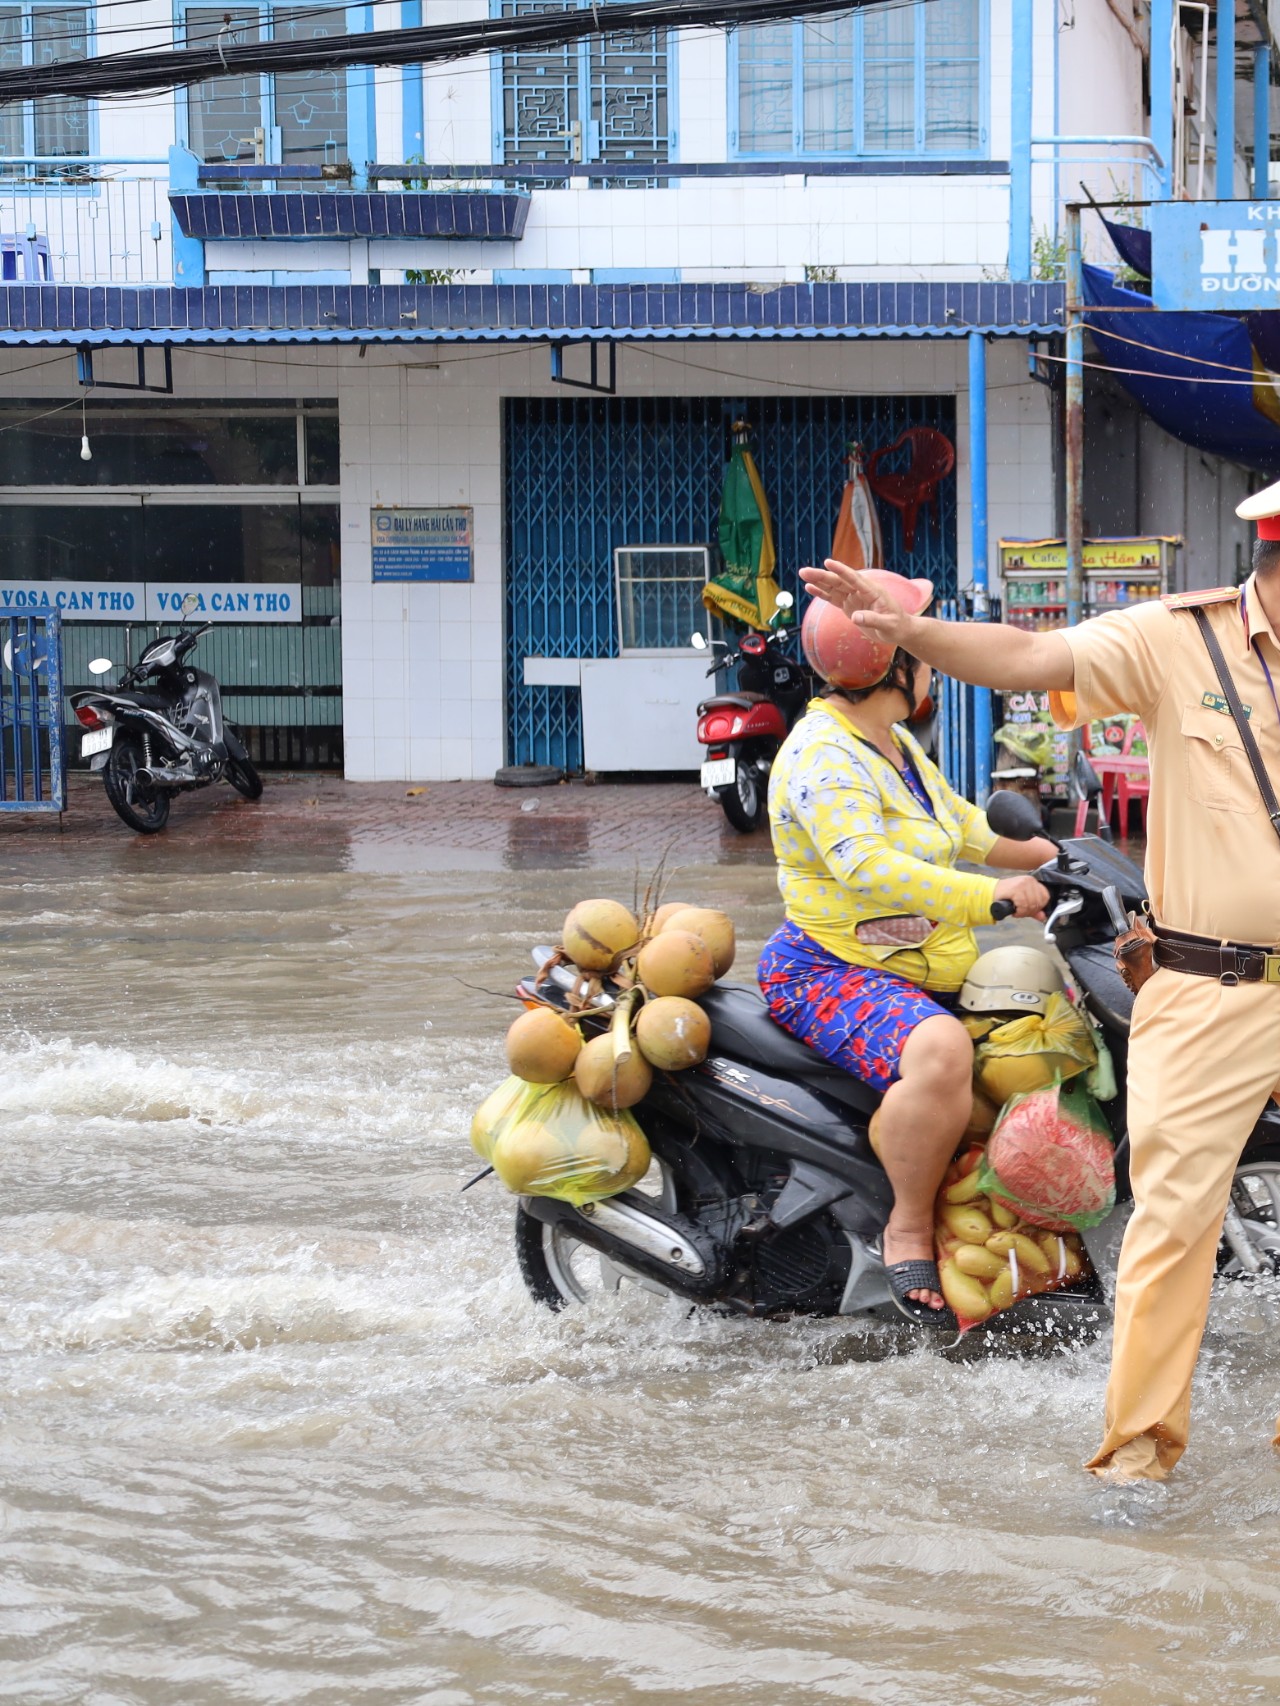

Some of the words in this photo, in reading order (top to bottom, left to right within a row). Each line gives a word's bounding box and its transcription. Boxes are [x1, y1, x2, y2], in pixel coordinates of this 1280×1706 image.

[1, 590, 50, 606] VOSA
[55, 590, 94, 610] CAN
[97, 591, 135, 611] THO
[157, 592, 207, 611] VOA
[211, 592, 250, 611] CAN
[253, 592, 291, 612] THO
